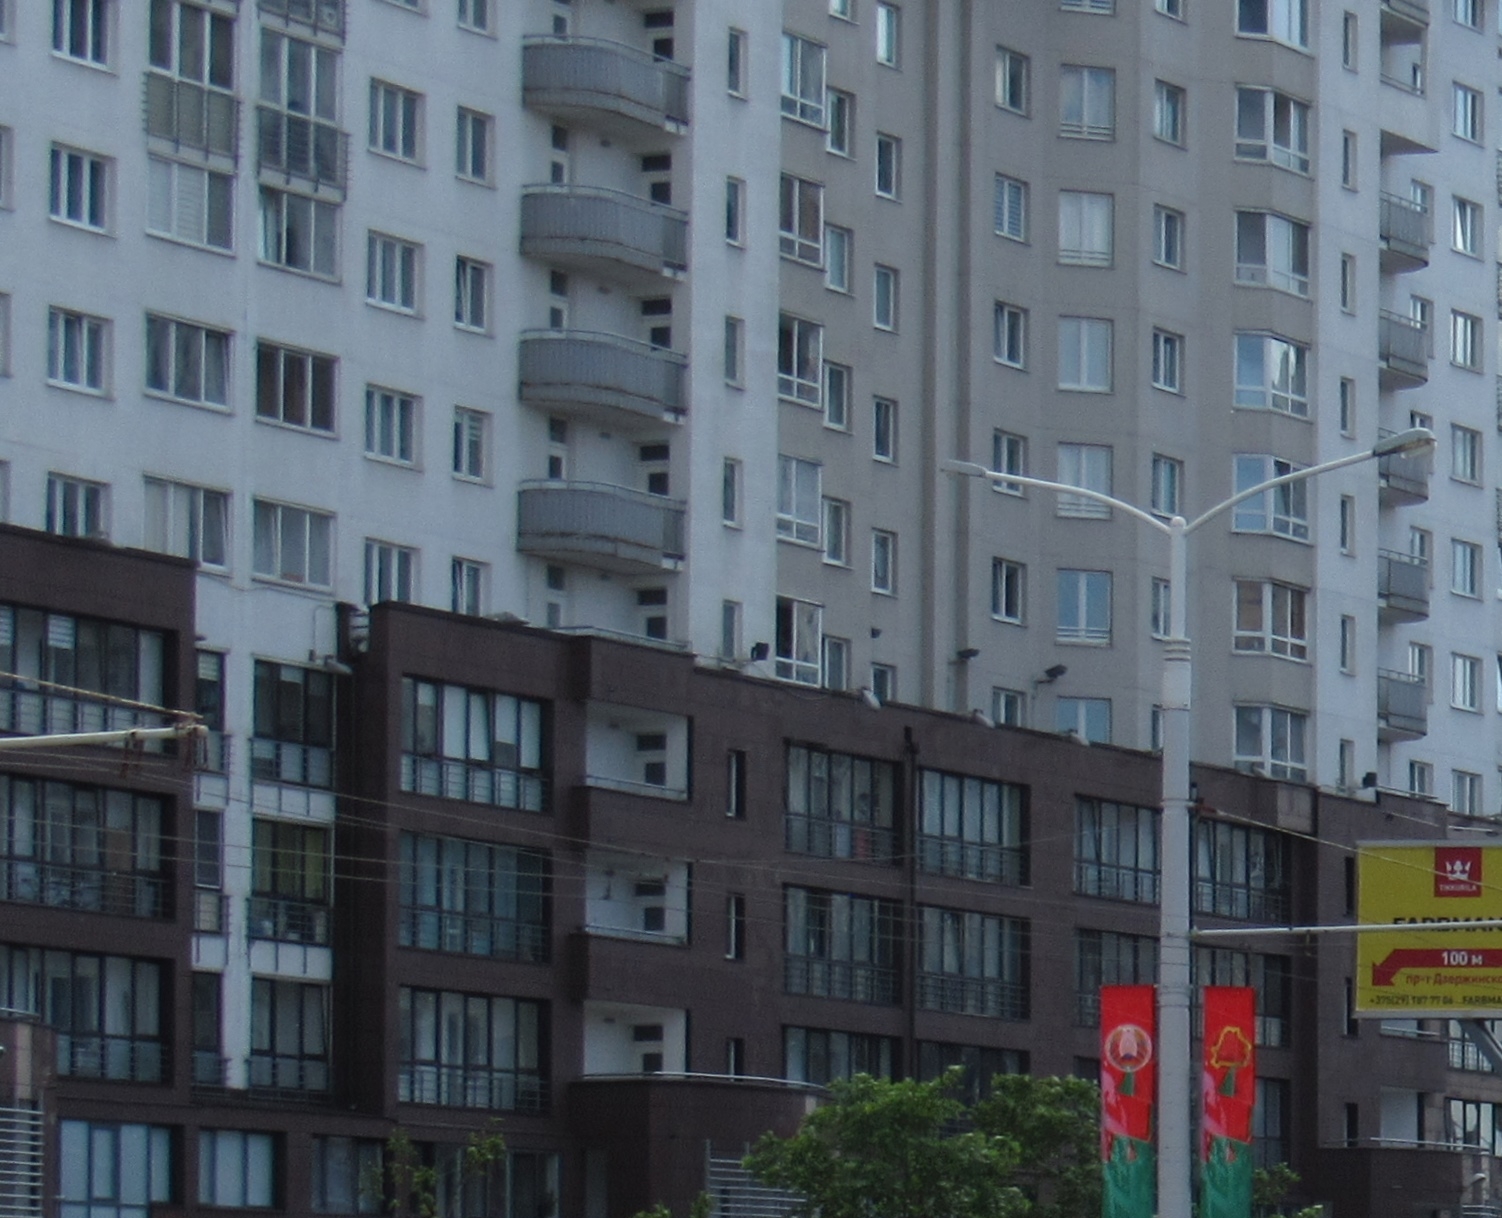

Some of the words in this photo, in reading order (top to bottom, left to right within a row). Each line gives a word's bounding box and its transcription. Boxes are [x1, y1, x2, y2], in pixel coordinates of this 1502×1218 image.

[1439, 884, 1477, 892] TIKKURILA
[1441, 951, 1469, 966] 100
[1471, 955, 1483, 966] м
[1405, 974, 1430, 987] пр-т
